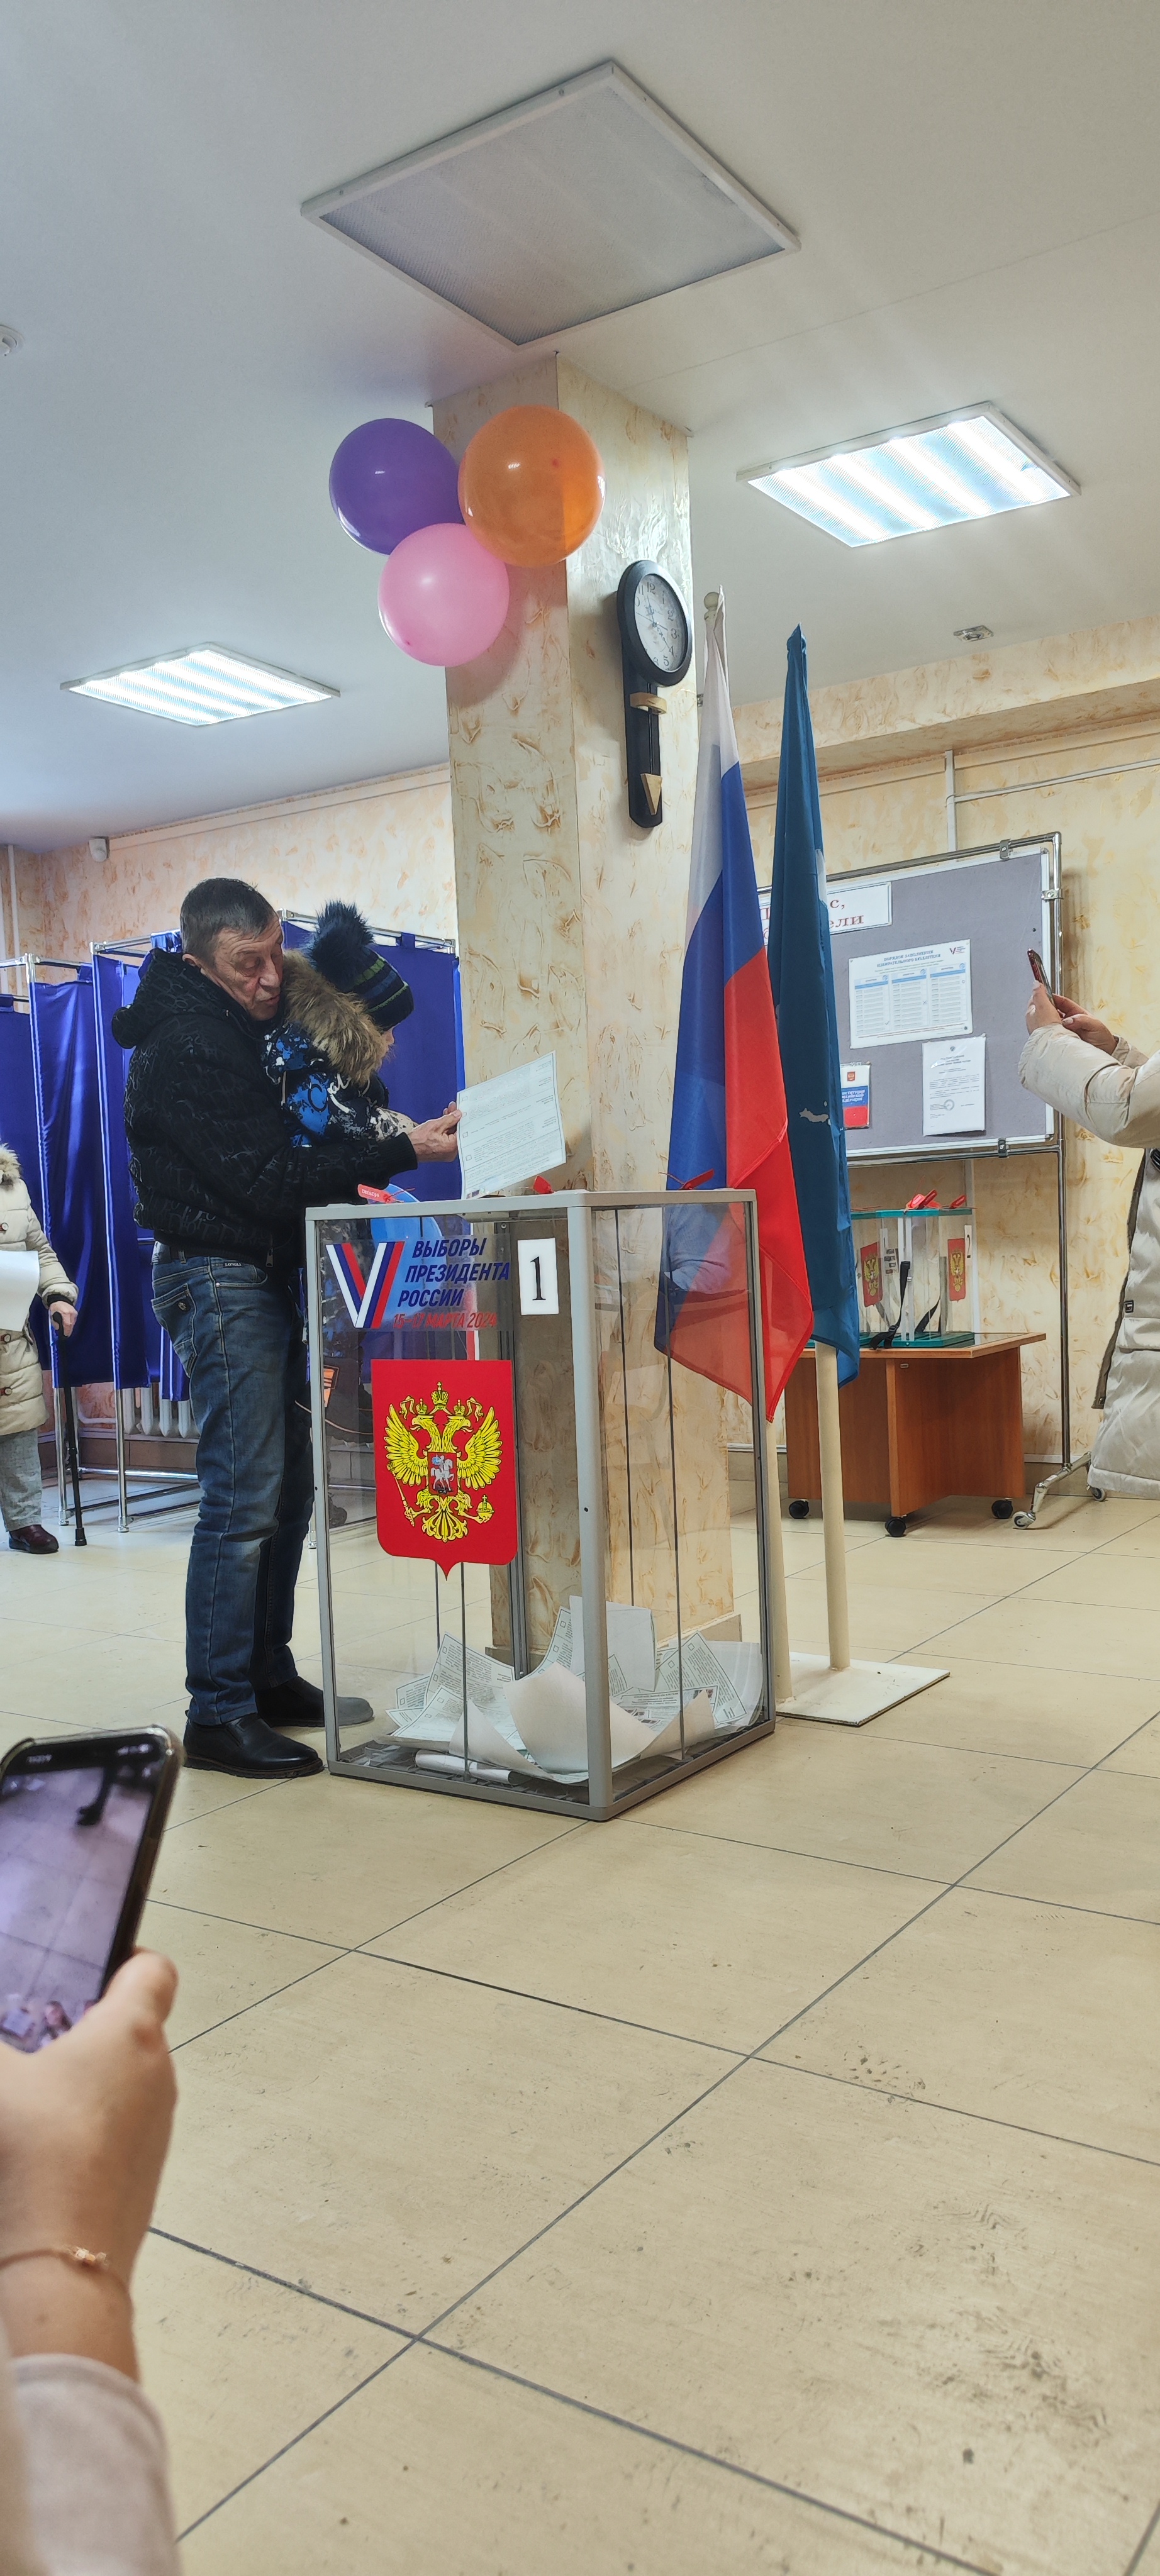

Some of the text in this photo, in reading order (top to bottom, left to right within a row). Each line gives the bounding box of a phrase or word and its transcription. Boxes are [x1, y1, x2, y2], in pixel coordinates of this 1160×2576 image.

[647, 582, 655, 595] 12
[667, 609, 674, 621] 2
[671, 628, 678, 639] 3
[663, 655, 669, 667] 5
[412, 1237, 488, 1258] ВЫБОРЫ
[404, 1262, 510, 1284] ПРЕЗИДЕНТА
[530, 1256, 547, 1301] 1
[397, 1289, 465, 1307] РОССИИ
[425, 1313, 465, 1329] МАРТА
[467, 1312, 497, 1328] 2024
